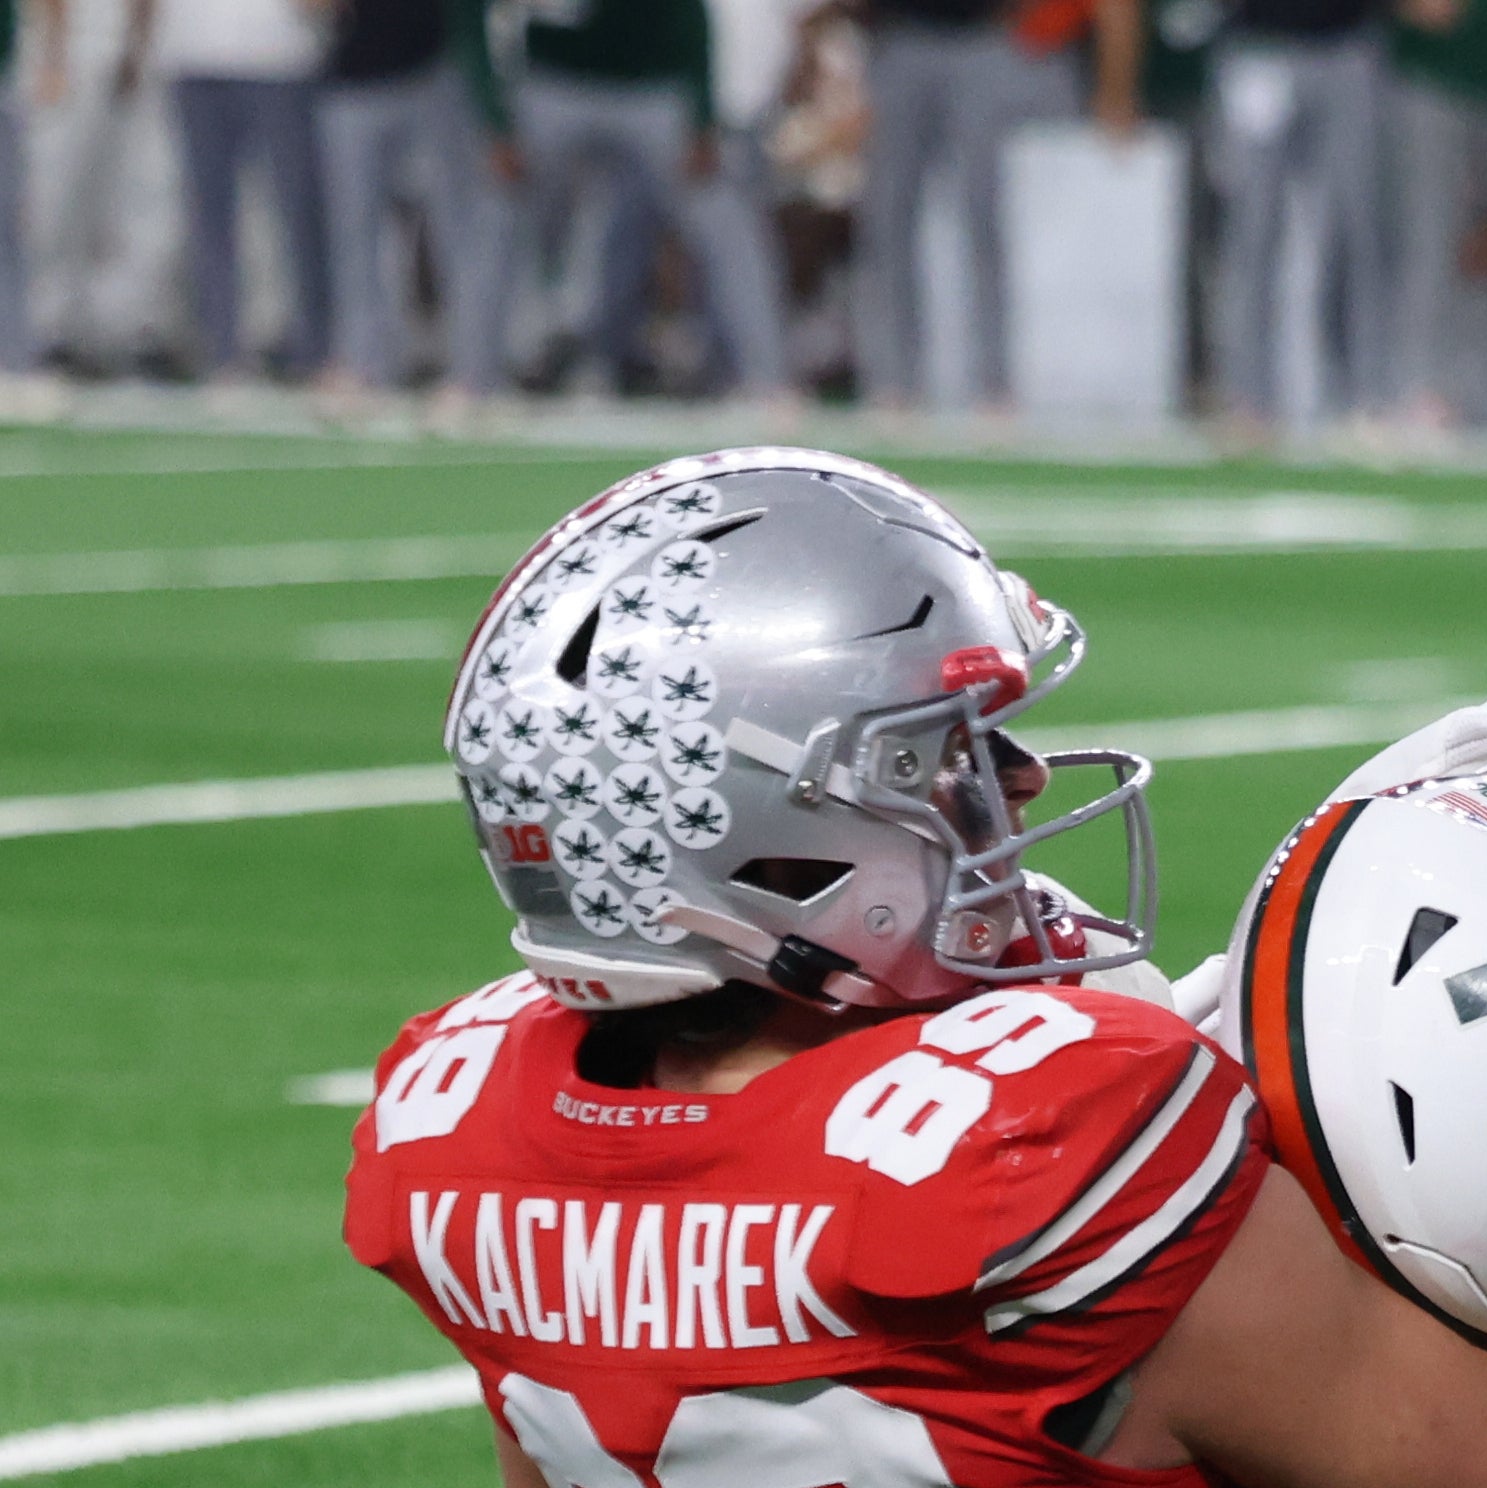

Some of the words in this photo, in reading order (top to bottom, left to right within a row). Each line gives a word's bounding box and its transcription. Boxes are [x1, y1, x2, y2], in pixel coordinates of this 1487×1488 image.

[552, 1090, 709, 1127] BUCKEYES
[825, 984, 1097, 1187] 89
[410, 1190, 858, 1350] KACMAREK
